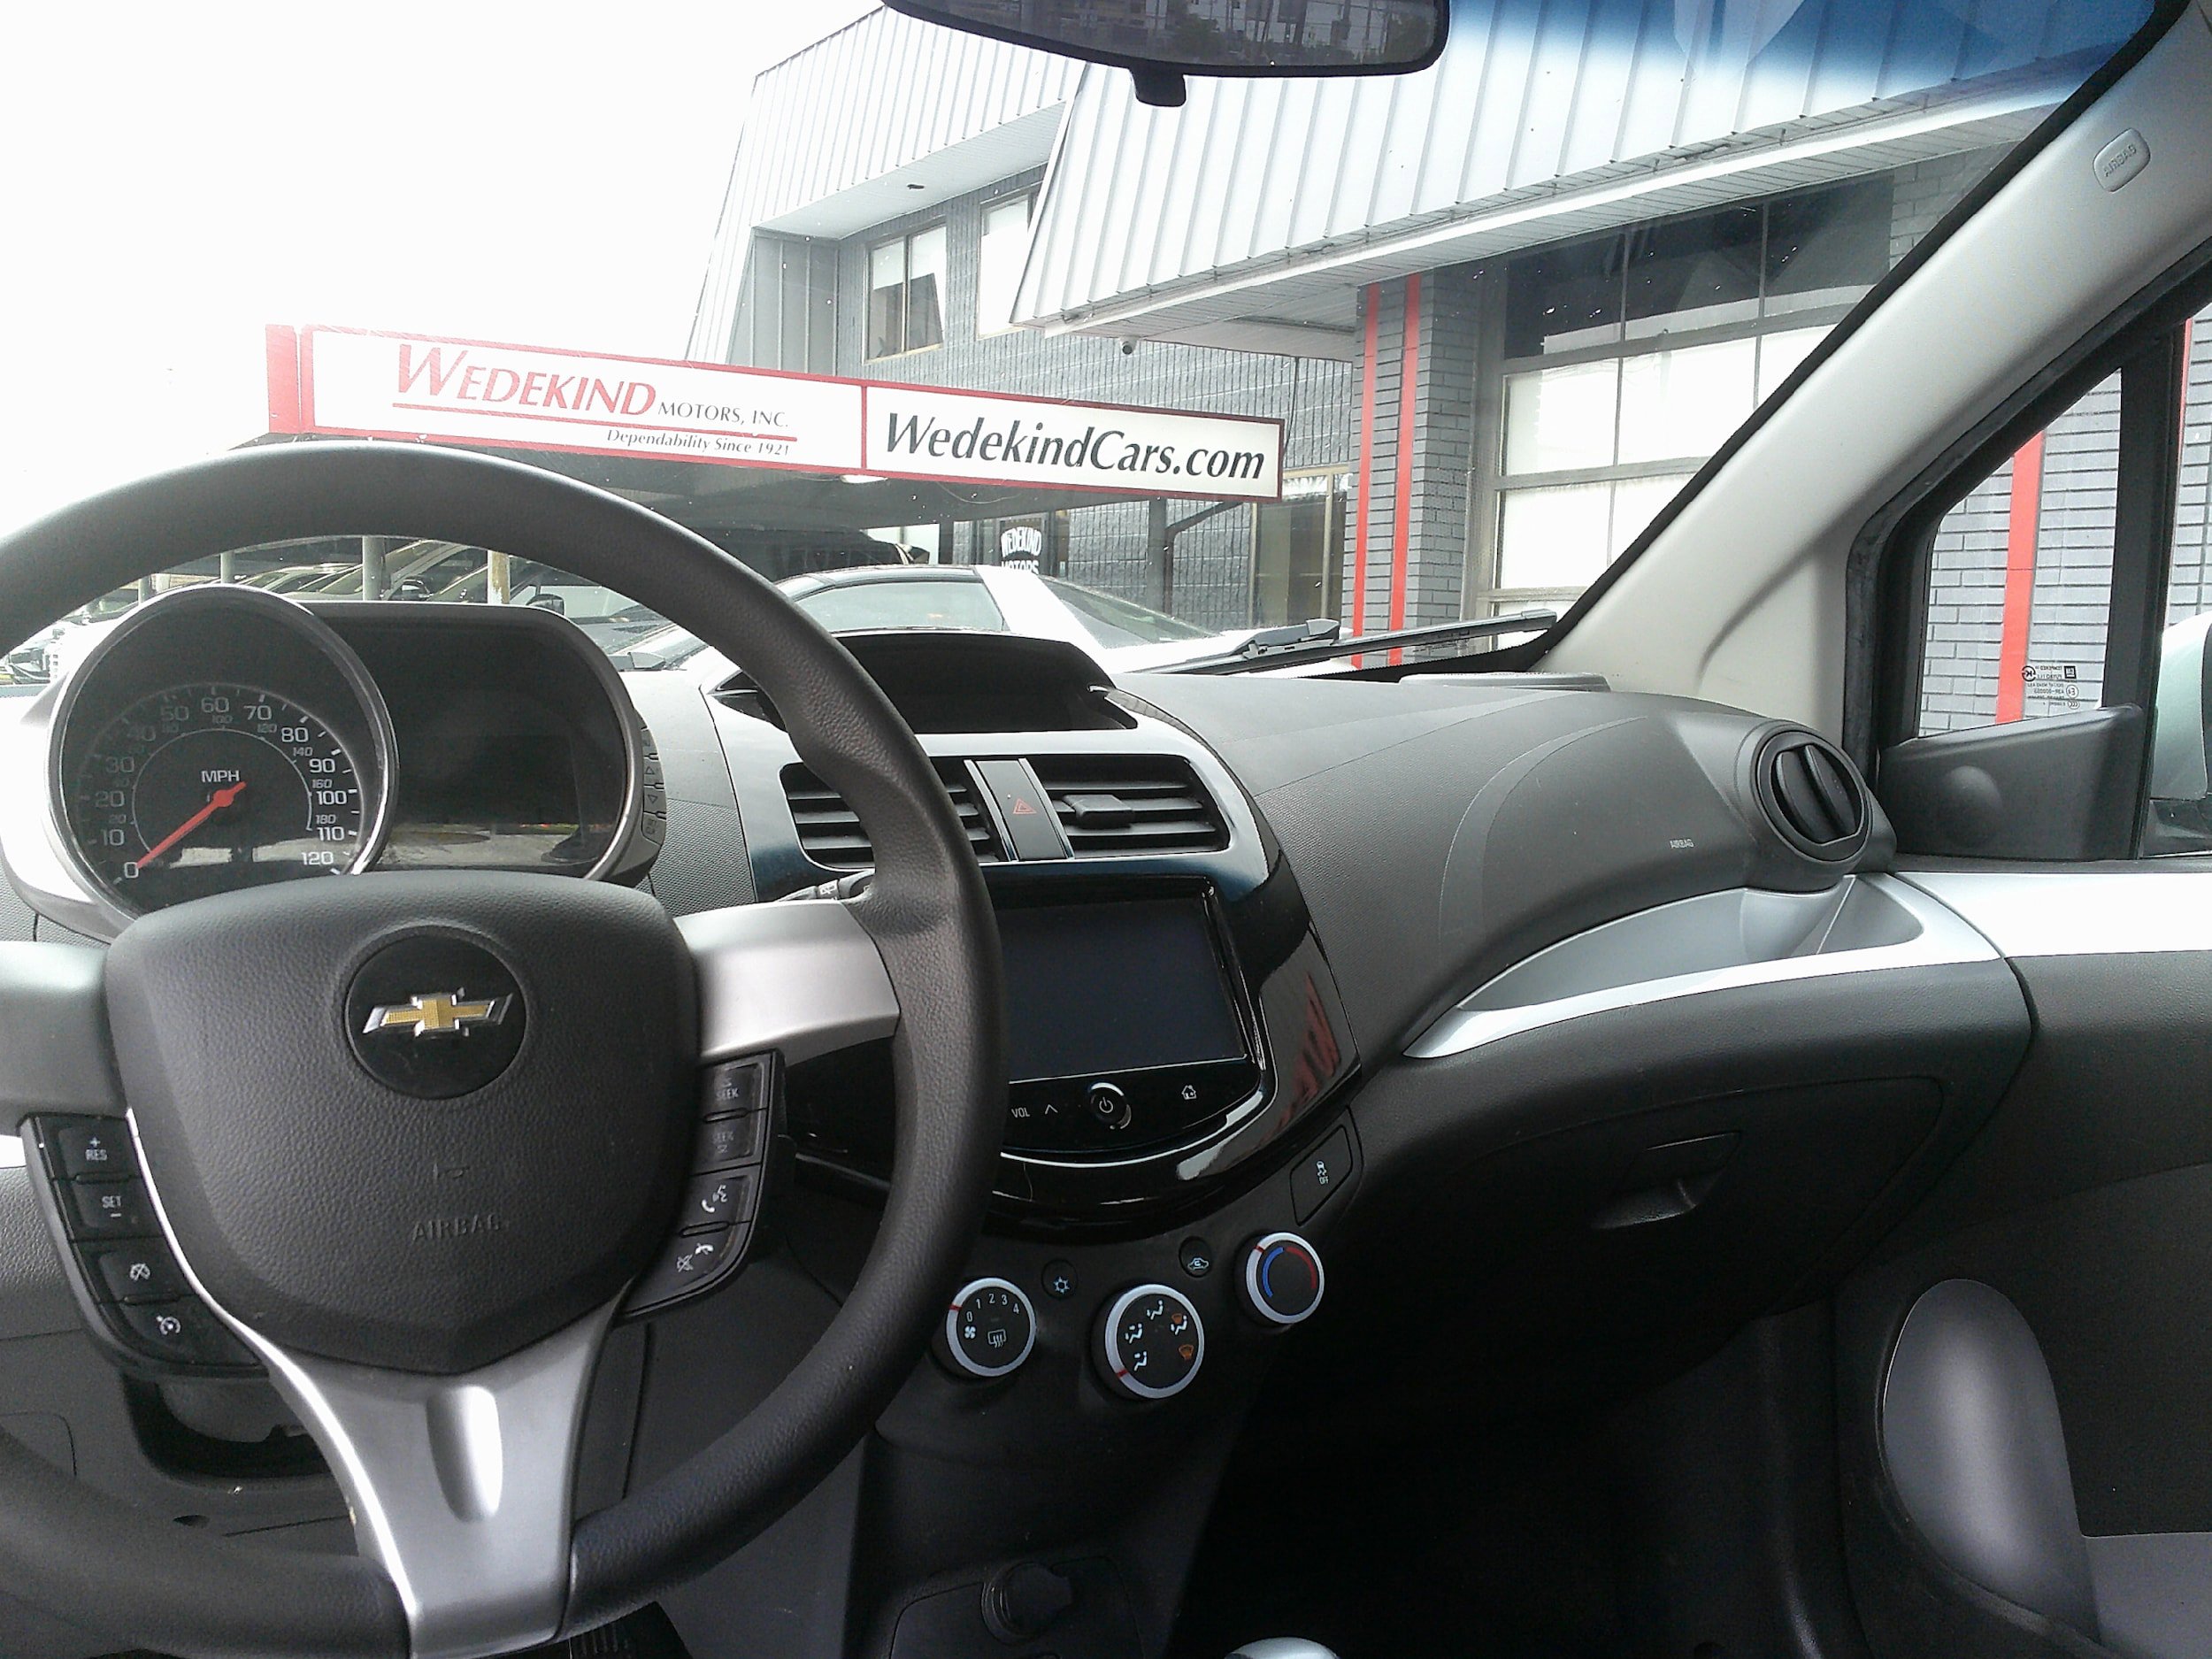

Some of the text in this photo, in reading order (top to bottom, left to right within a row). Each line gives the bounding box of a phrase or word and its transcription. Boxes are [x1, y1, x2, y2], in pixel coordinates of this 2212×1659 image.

[398, 343, 789, 428] WEDEKIND MOTORS, INC.
[607, 428, 710, 453] Dependability
[715, 434, 752, 453] Since
[886, 412, 1265, 480] WedekindCars.com
[1001, 526, 1042, 557] WEDEKIND
[201, 696, 229, 713] 60
[160, 706, 189, 721] 50
[243, 705, 273, 721] 70
[280, 726, 309, 743] 80
[293, 747, 312, 757] 140
[105, 757, 135, 773] 30
[310, 758, 335, 774] 90
[201, 770, 241, 783] MPH
[95, 792, 125, 808] 20
[316, 791, 347, 806] 100
[102, 829, 125, 847] 10
[317, 826, 344, 841] 110
[302, 851, 334, 866] 120
[124, 862, 139, 879] 0
[716, 1087, 739, 1101] SEEK
[1011, 1107, 1031, 1119] VOL
[86, 1149, 107, 1161] RES
[102, 1196, 122, 1208] SET
[966, 1293, 1020, 1322] 0 1 2 3 4
